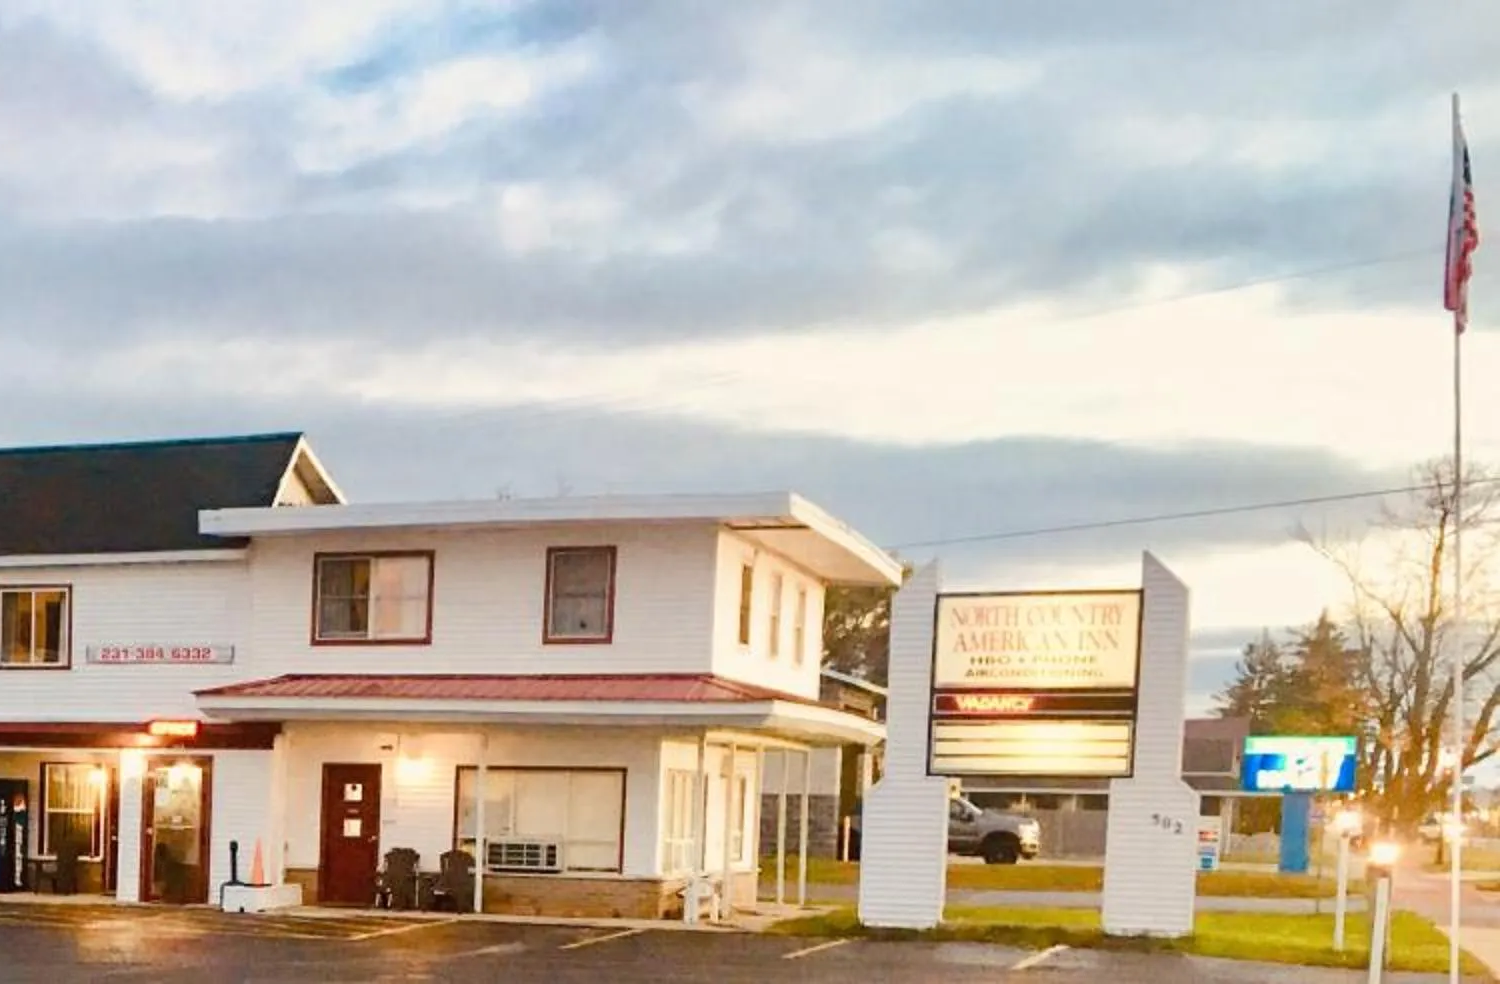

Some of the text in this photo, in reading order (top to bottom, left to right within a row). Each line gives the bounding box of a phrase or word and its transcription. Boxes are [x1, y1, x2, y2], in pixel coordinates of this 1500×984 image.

[951, 603, 1125, 629] NORTH COUNTRY
[953, 629, 1119, 653] AMERICAN INN
[969, 655, 1011, 665] HBO
